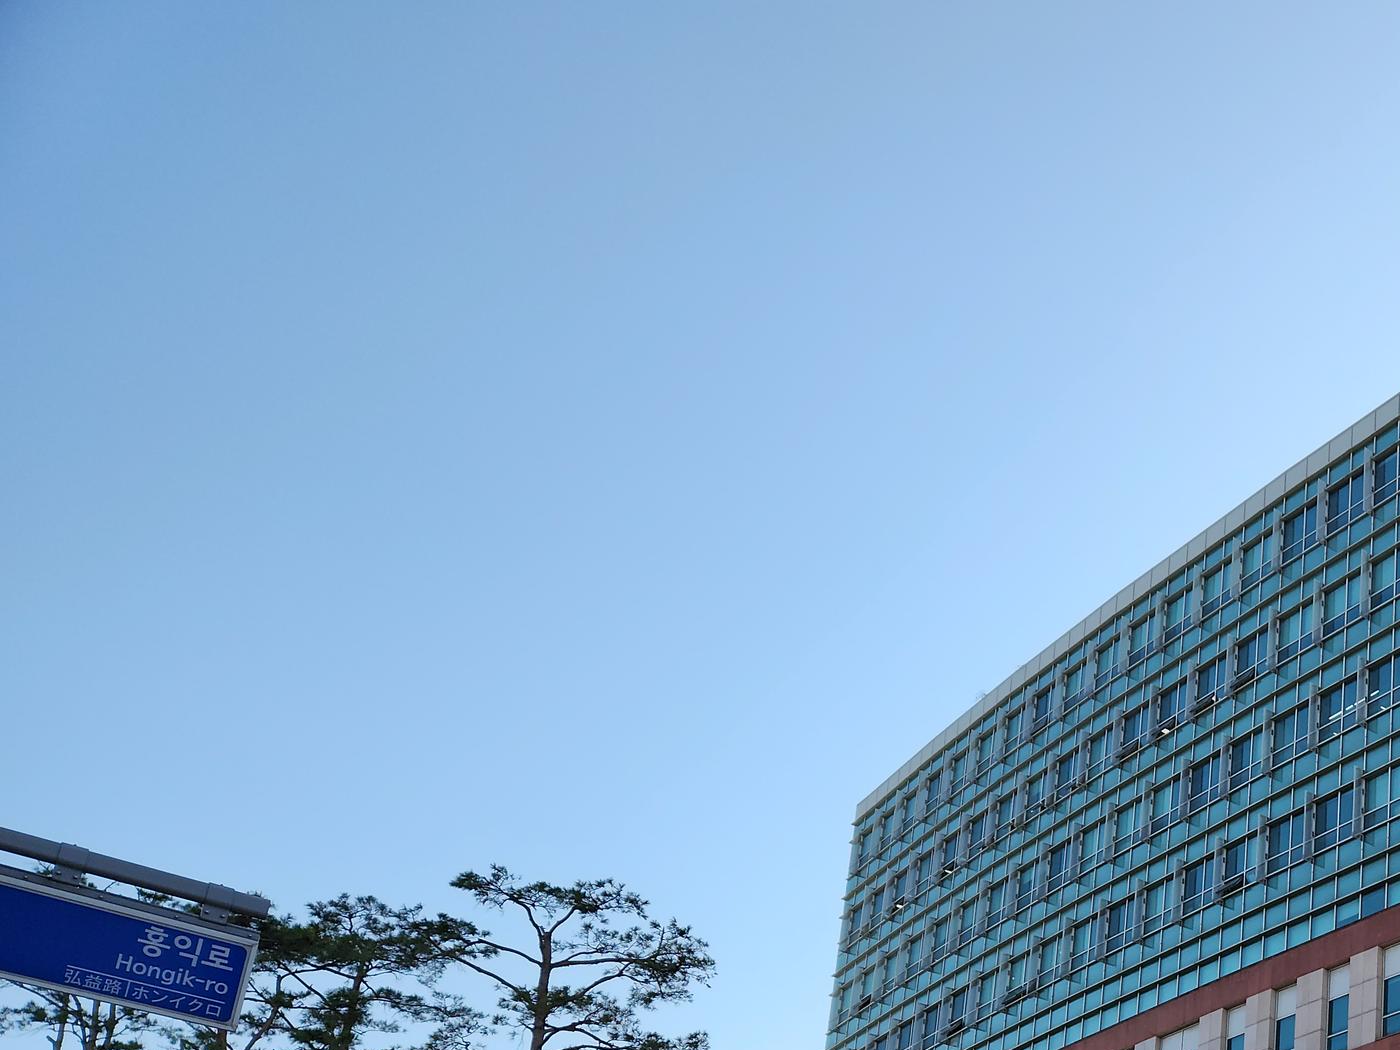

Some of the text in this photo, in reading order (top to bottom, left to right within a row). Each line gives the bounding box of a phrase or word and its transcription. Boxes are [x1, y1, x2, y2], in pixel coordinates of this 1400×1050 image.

[137, 925, 234, 972] 홍익로
[64, 968, 222, 1018] 弘益路 ホンイクロ
[115, 953, 228, 995] Hongik-ro
